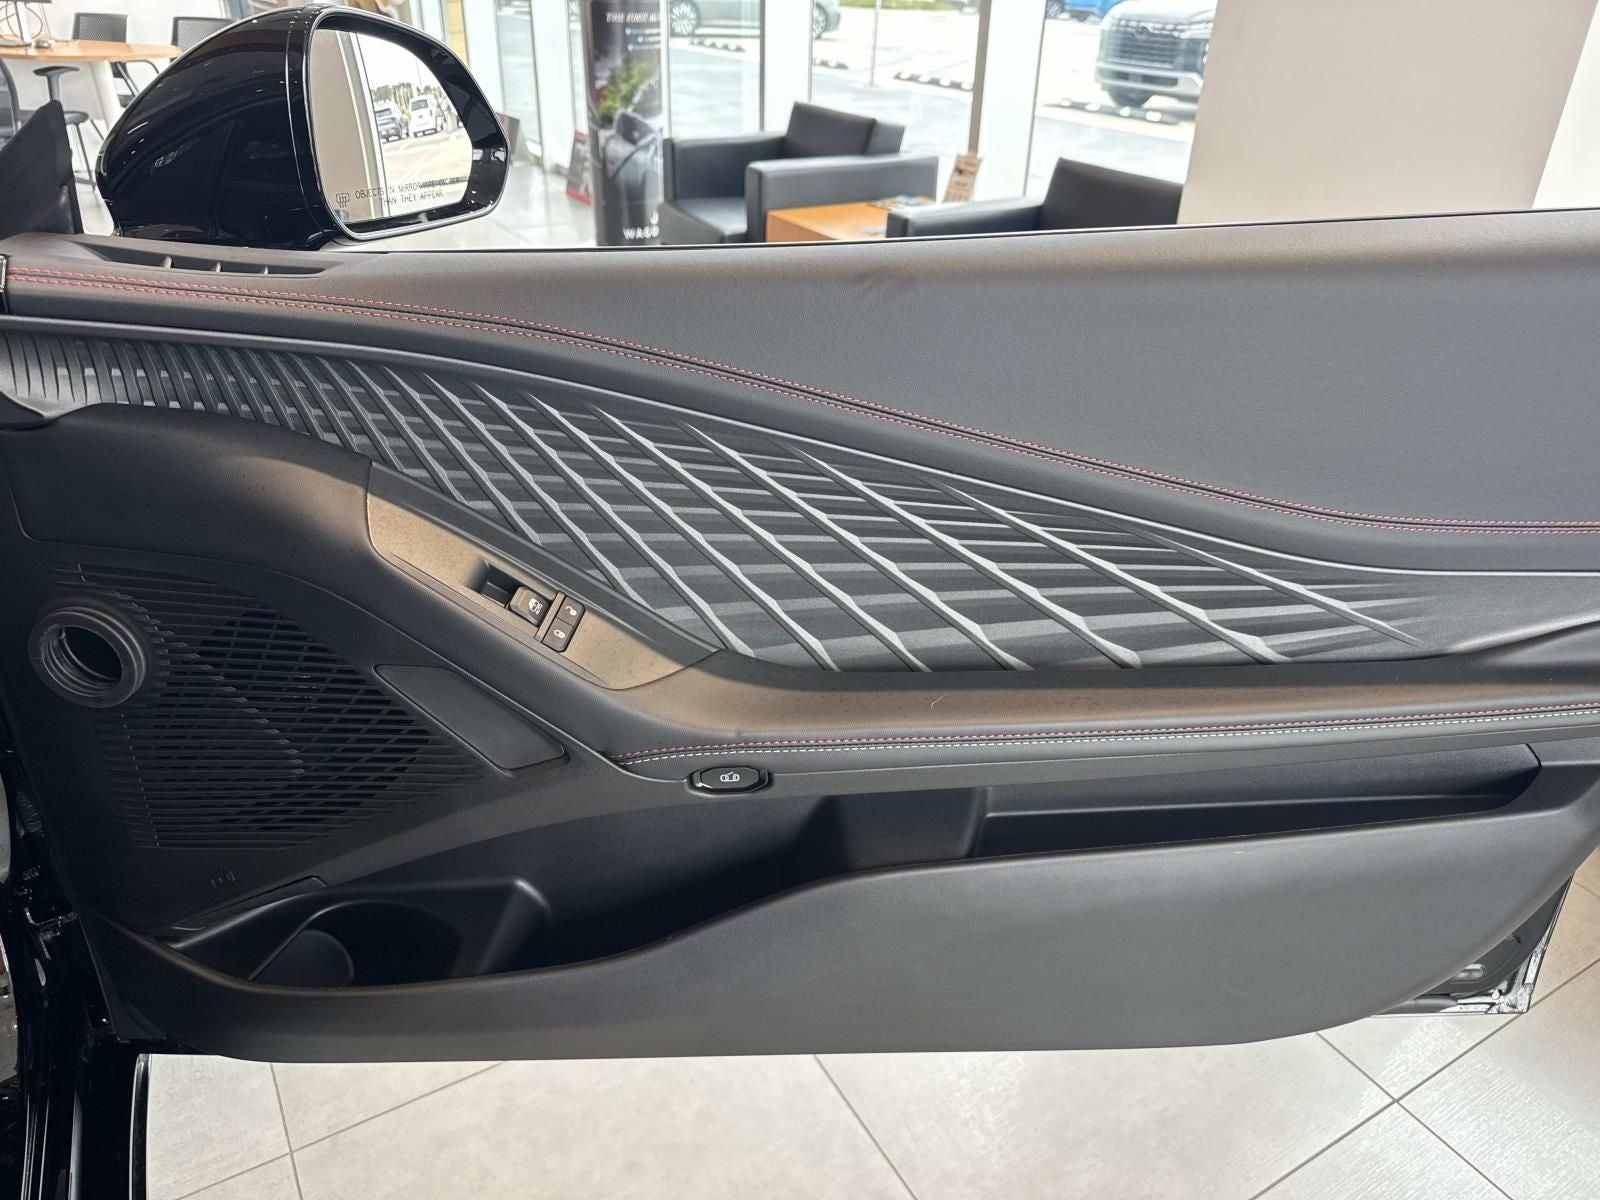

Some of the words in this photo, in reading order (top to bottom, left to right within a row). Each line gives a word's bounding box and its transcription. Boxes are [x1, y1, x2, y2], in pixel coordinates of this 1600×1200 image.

[355, 187, 385, 200] OBJECTS
[400, 193, 417, 204] THEY
[420, 189, 444, 201] APPEAR
